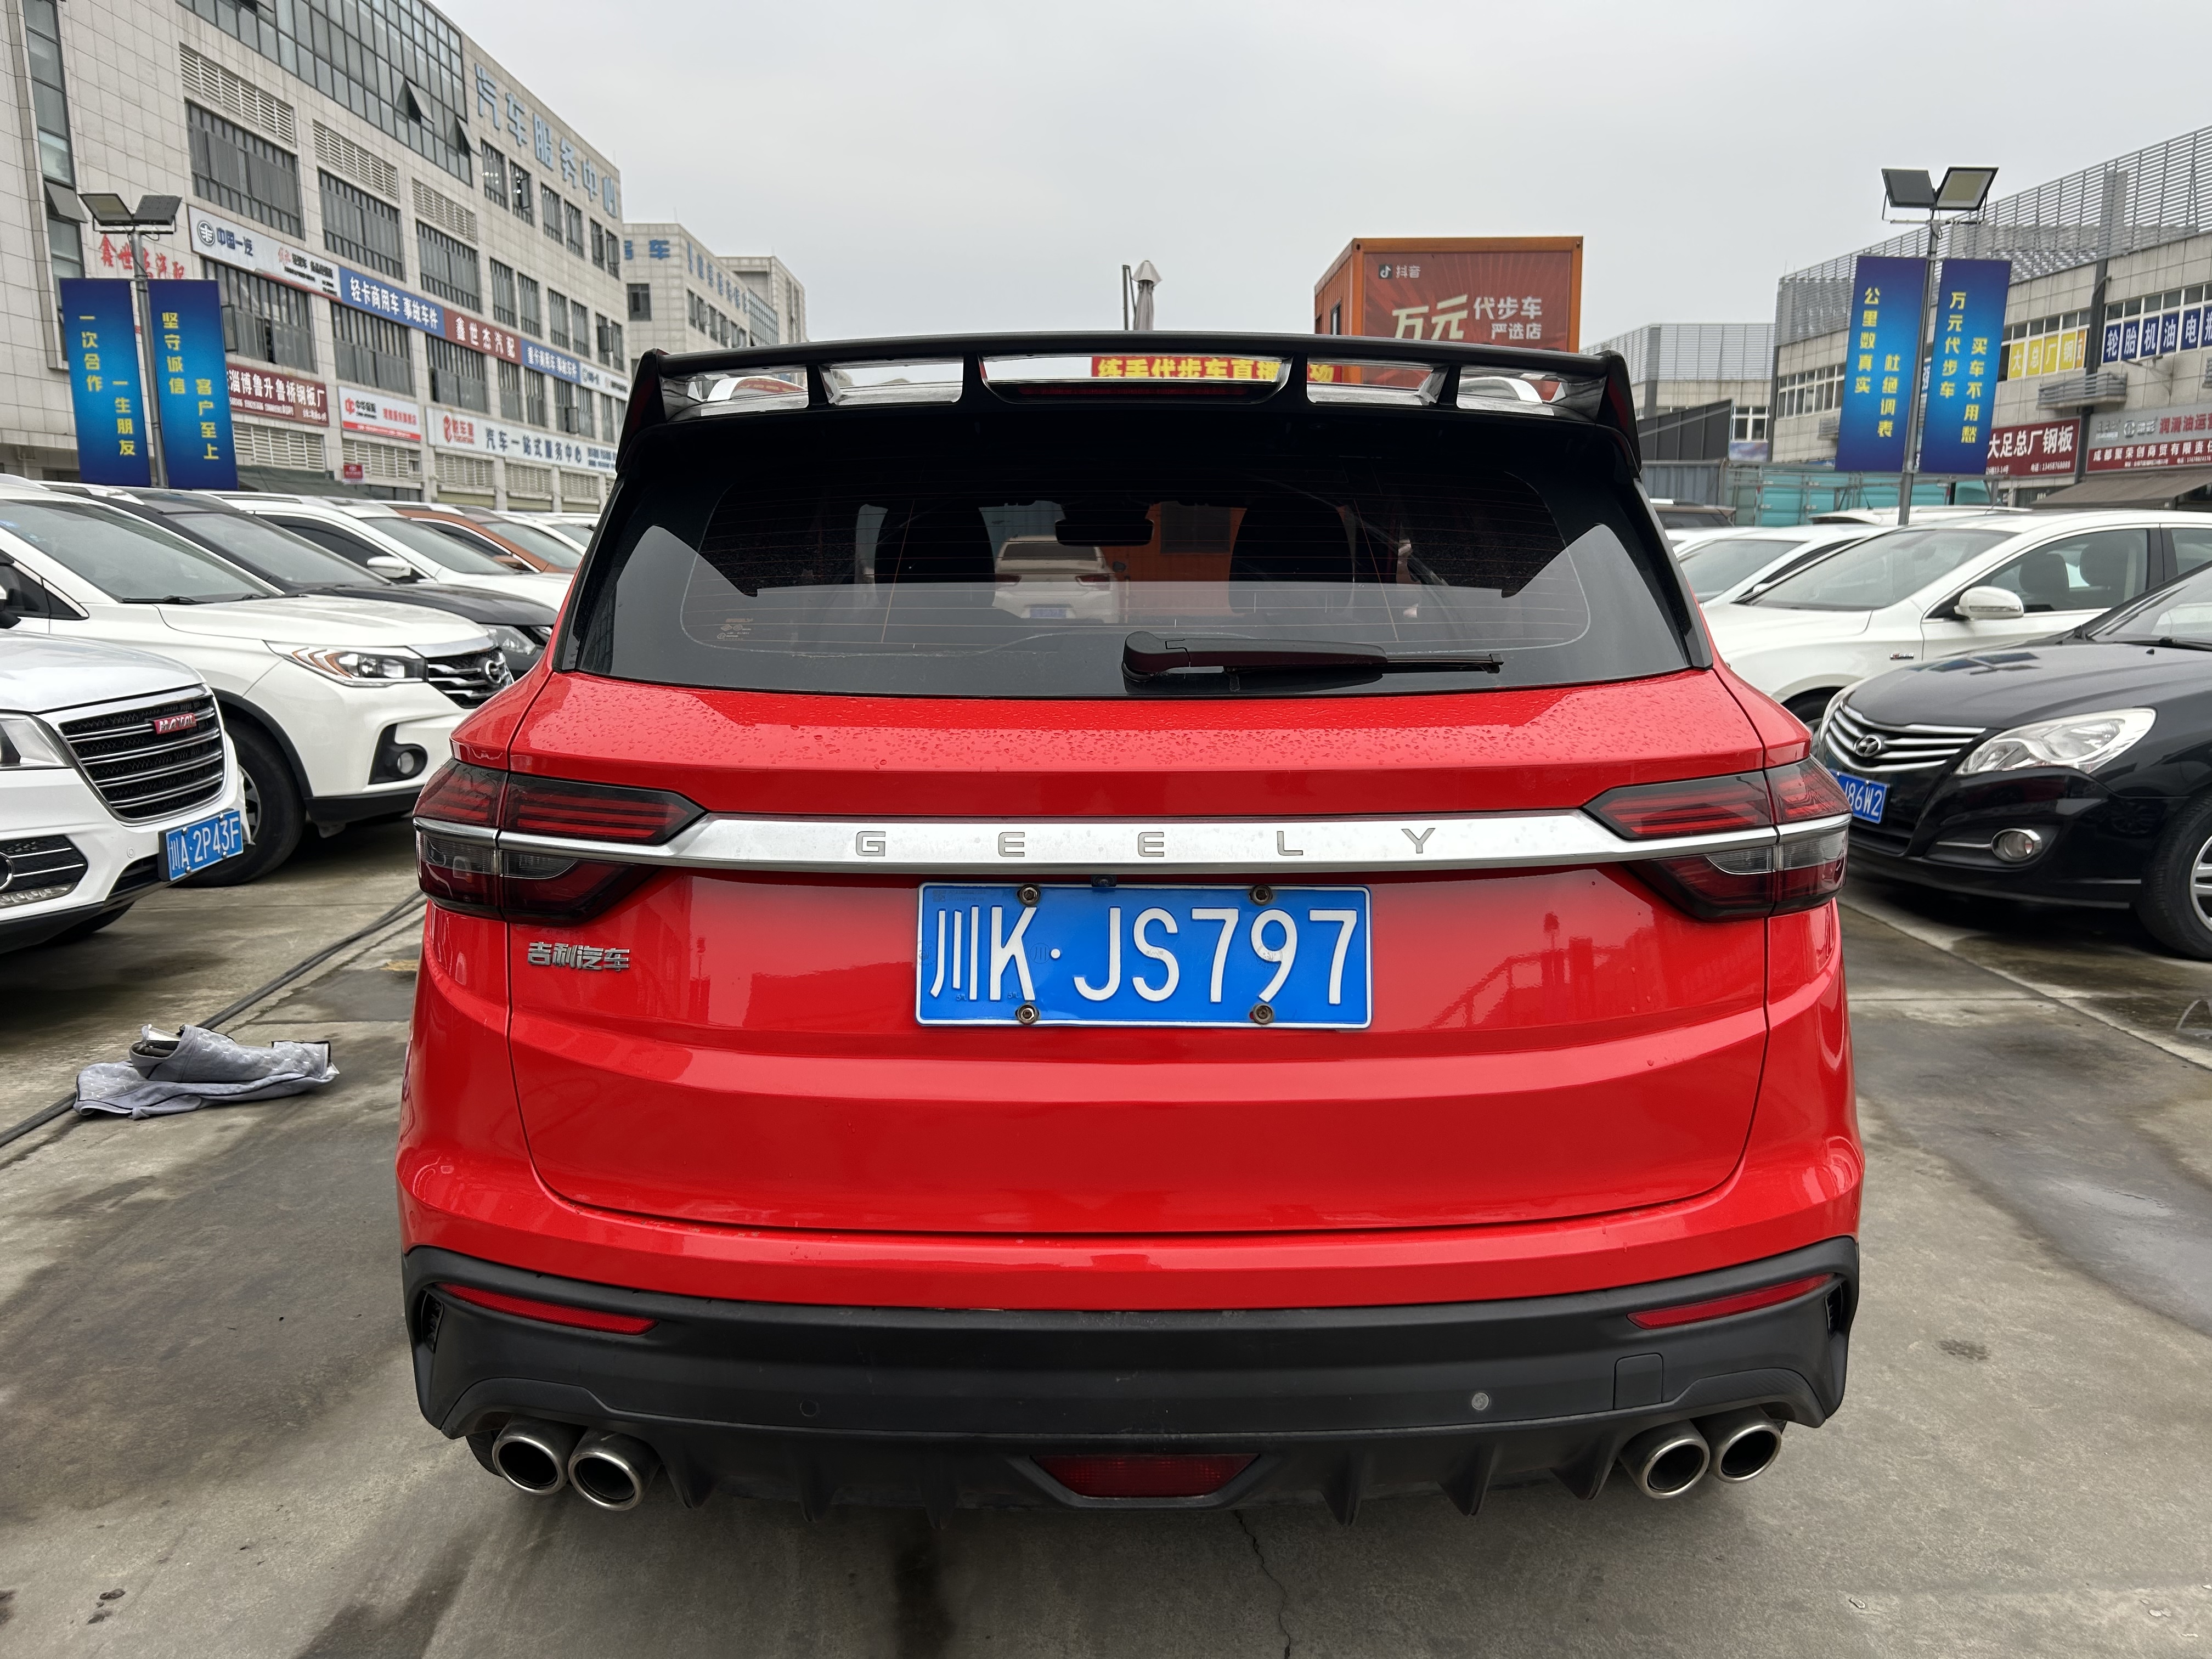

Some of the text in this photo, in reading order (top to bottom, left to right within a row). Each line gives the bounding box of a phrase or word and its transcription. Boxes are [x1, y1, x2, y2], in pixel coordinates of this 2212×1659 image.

[216, 227, 253, 256] 中国一汽
[1396, 264, 1421, 279] 抖音
[350, 275, 400, 315] 轻卡商用车
[455, 316, 515, 358] 鑫世杰汽配
[1391, 294, 1542, 340] 万元 代步车
[1491, 323, 1542, 340] 严选店
[79, 315, 103, 391] 一次合作
[162, 312, 185, 394] 坚守诚信
[1854, 287, 1880, 394] 公里数真实
[1940, 291, 1967, 398] 万元代步车
[227, 369, 325, 408] 淄博鲁升鲁桥钢板厂
[1877, 354, 1900, 437] 杜绝调表
[1961, 337, 1988, 443] 买车不用愁
[112, 381, 136, 455] 一生朋友
[196, 379, 219, 460] 客户至上
[486, 427, 582, 464] 汽车一站式服务中心
[1987, 425, 2074, 460] 大足总厂钢板
[159, 715, 196, 732] HAVAL
[855, 827, 1435, 857] GEELY
[527, 941, 630, 972] 吉利汽车
[930, 906, 1358, 1005] 川K·JS797
